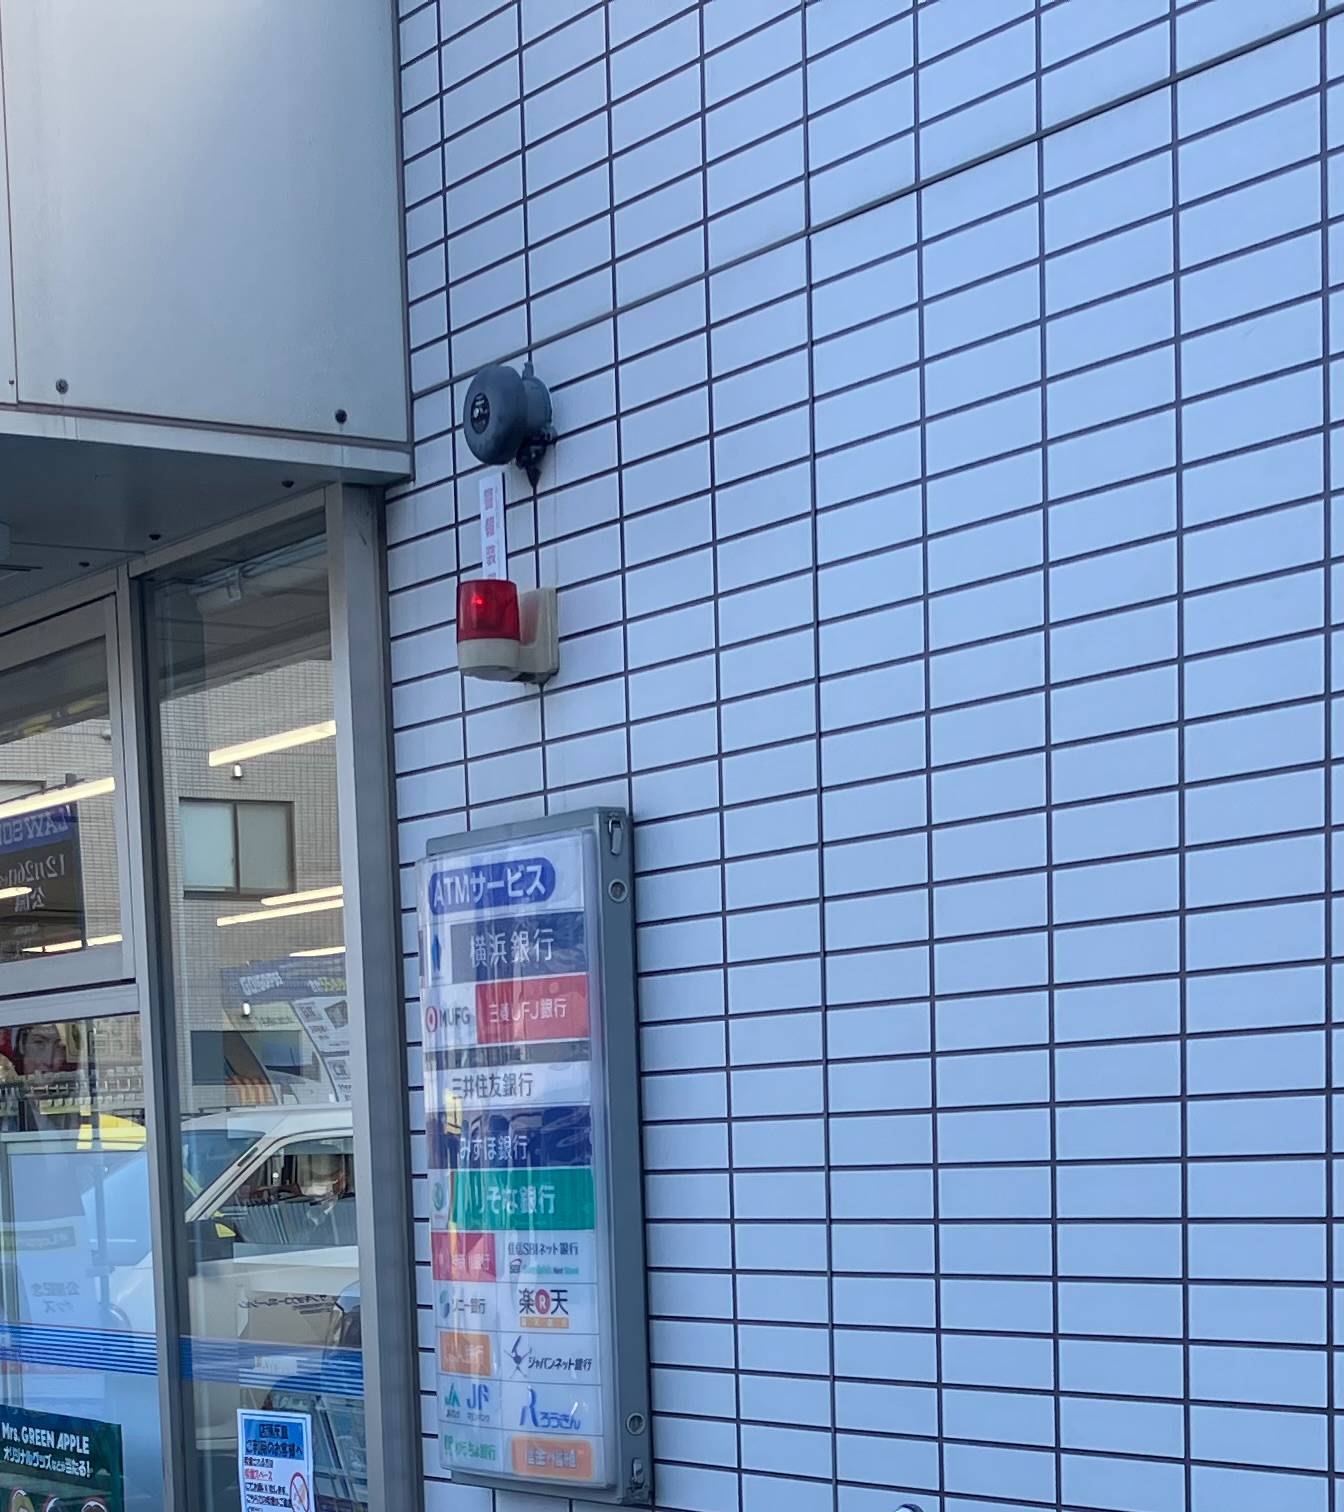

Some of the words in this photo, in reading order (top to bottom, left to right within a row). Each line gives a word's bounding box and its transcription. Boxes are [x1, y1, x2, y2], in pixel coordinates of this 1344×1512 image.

[433, 865, 546, 905] ATMサービス
[470, 928, 554, 966] 横浜銀行
[451, 1073, 534, 1099] 三井住友銀行
[539, 1409, 581, 1432] ろうきん
[1, 1422, 20, 1442] Mrs.
[21, 1425, 56, 1449] GREEN
[56, 1432, 90, 1455] APPLE
